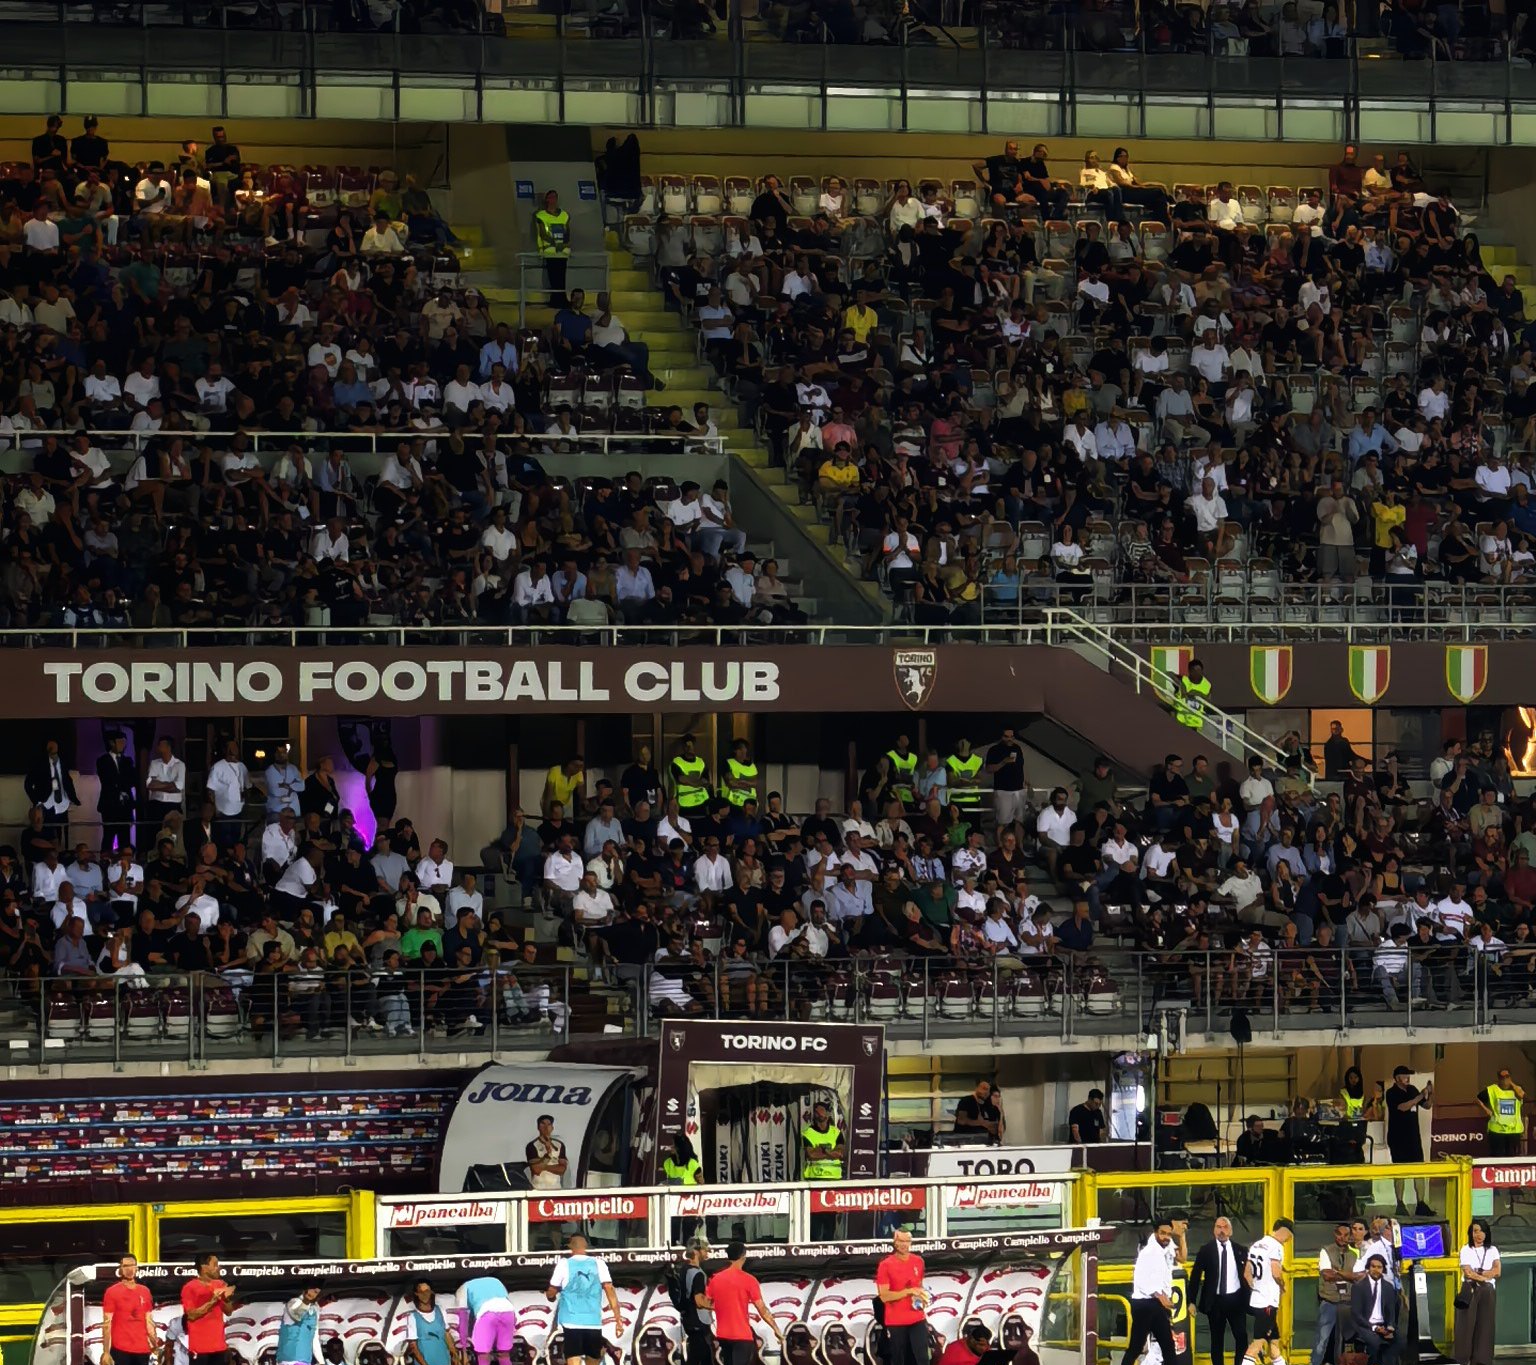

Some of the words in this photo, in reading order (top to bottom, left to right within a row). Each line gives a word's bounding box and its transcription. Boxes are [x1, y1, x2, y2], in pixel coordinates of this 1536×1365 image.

[44, 661, 283, 703] TORINO
[299, 661, 609, 703] FOOTBALL
[624, 661, 780, 702] CLUB
[721, 1034, 797, 1051] TORINO
[801, 1037, 828, 1051] FC
[1469, 1132, 1484, 1142] FC
[538, 1197, 635, 1220] Campiello
[819, 1187, 913, 1210] Campiello
[233, 1265, 285, 1277] Campiello
[291, 1265, 343, 1277] Campiello
[349, 1262, 400, 1275] Campiello
[405, 1259, 456, 1273] Campiello
[517, 1255, 562, 1267] Campiell
[745, 1246, 787, 1258] ampiello
[791, 1245, 841, 1257] Campiello
[845, 1243, 894, 1256] Campiello
[952, 1237, 999, 1250] Campiello
[1004, 1235, 1050, 1248] Campiello
[1054, 1231, 1101, 1244] Campiello
